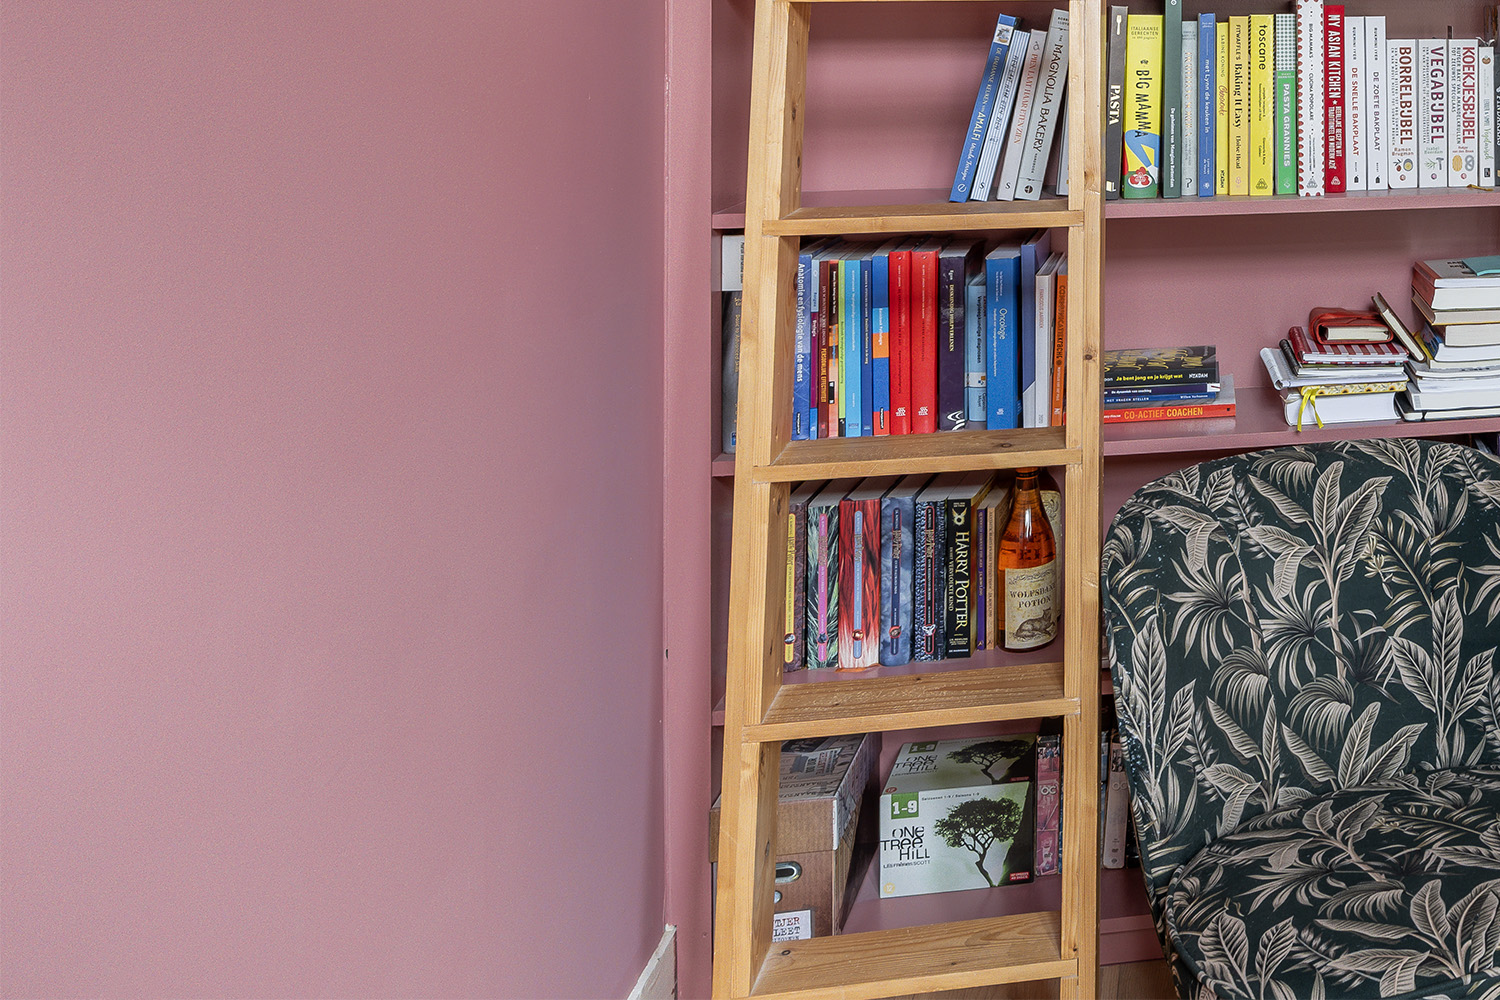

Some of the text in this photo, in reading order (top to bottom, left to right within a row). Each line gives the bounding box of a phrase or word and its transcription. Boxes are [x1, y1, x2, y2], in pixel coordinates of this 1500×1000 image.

[1327, 14, 1341, 27] MY
[1258, 24, 1268, 71] toscane
[1327, 31, 1341, 59] ASIAN
[1233, 63, 1243, 97] Baking
[1328, 61, 1342, 99] KITCHEN
[1351, 67, 1358, 80] DE
[1373, 71, 1380, 82] DE
[1032, 42, 1064, 154] MAGNOLIA BAKERY
[1109, 84, 1122, 126] PASTA
[1134, 69, 1153, 138] BIG MAMMA
[970, 111, 987, 142] AMALFI
[1232, 108, 1242, 129] Easy
[1282, 82, 1292, 168] PASTA GRANNIES
[998, 308, 1008, 340] Oncologie
[1123, 373, 1133, 381] bent
[1134, 373, 1146, 382] jong
[1124, 407, 1203, 420] CO-ACTIEF COACHEN
[955, 531, 970, 632] HARRY POTTER
[1017, 596, 1051, 609] POTION
[892, 801, 919, 816] 1-9
